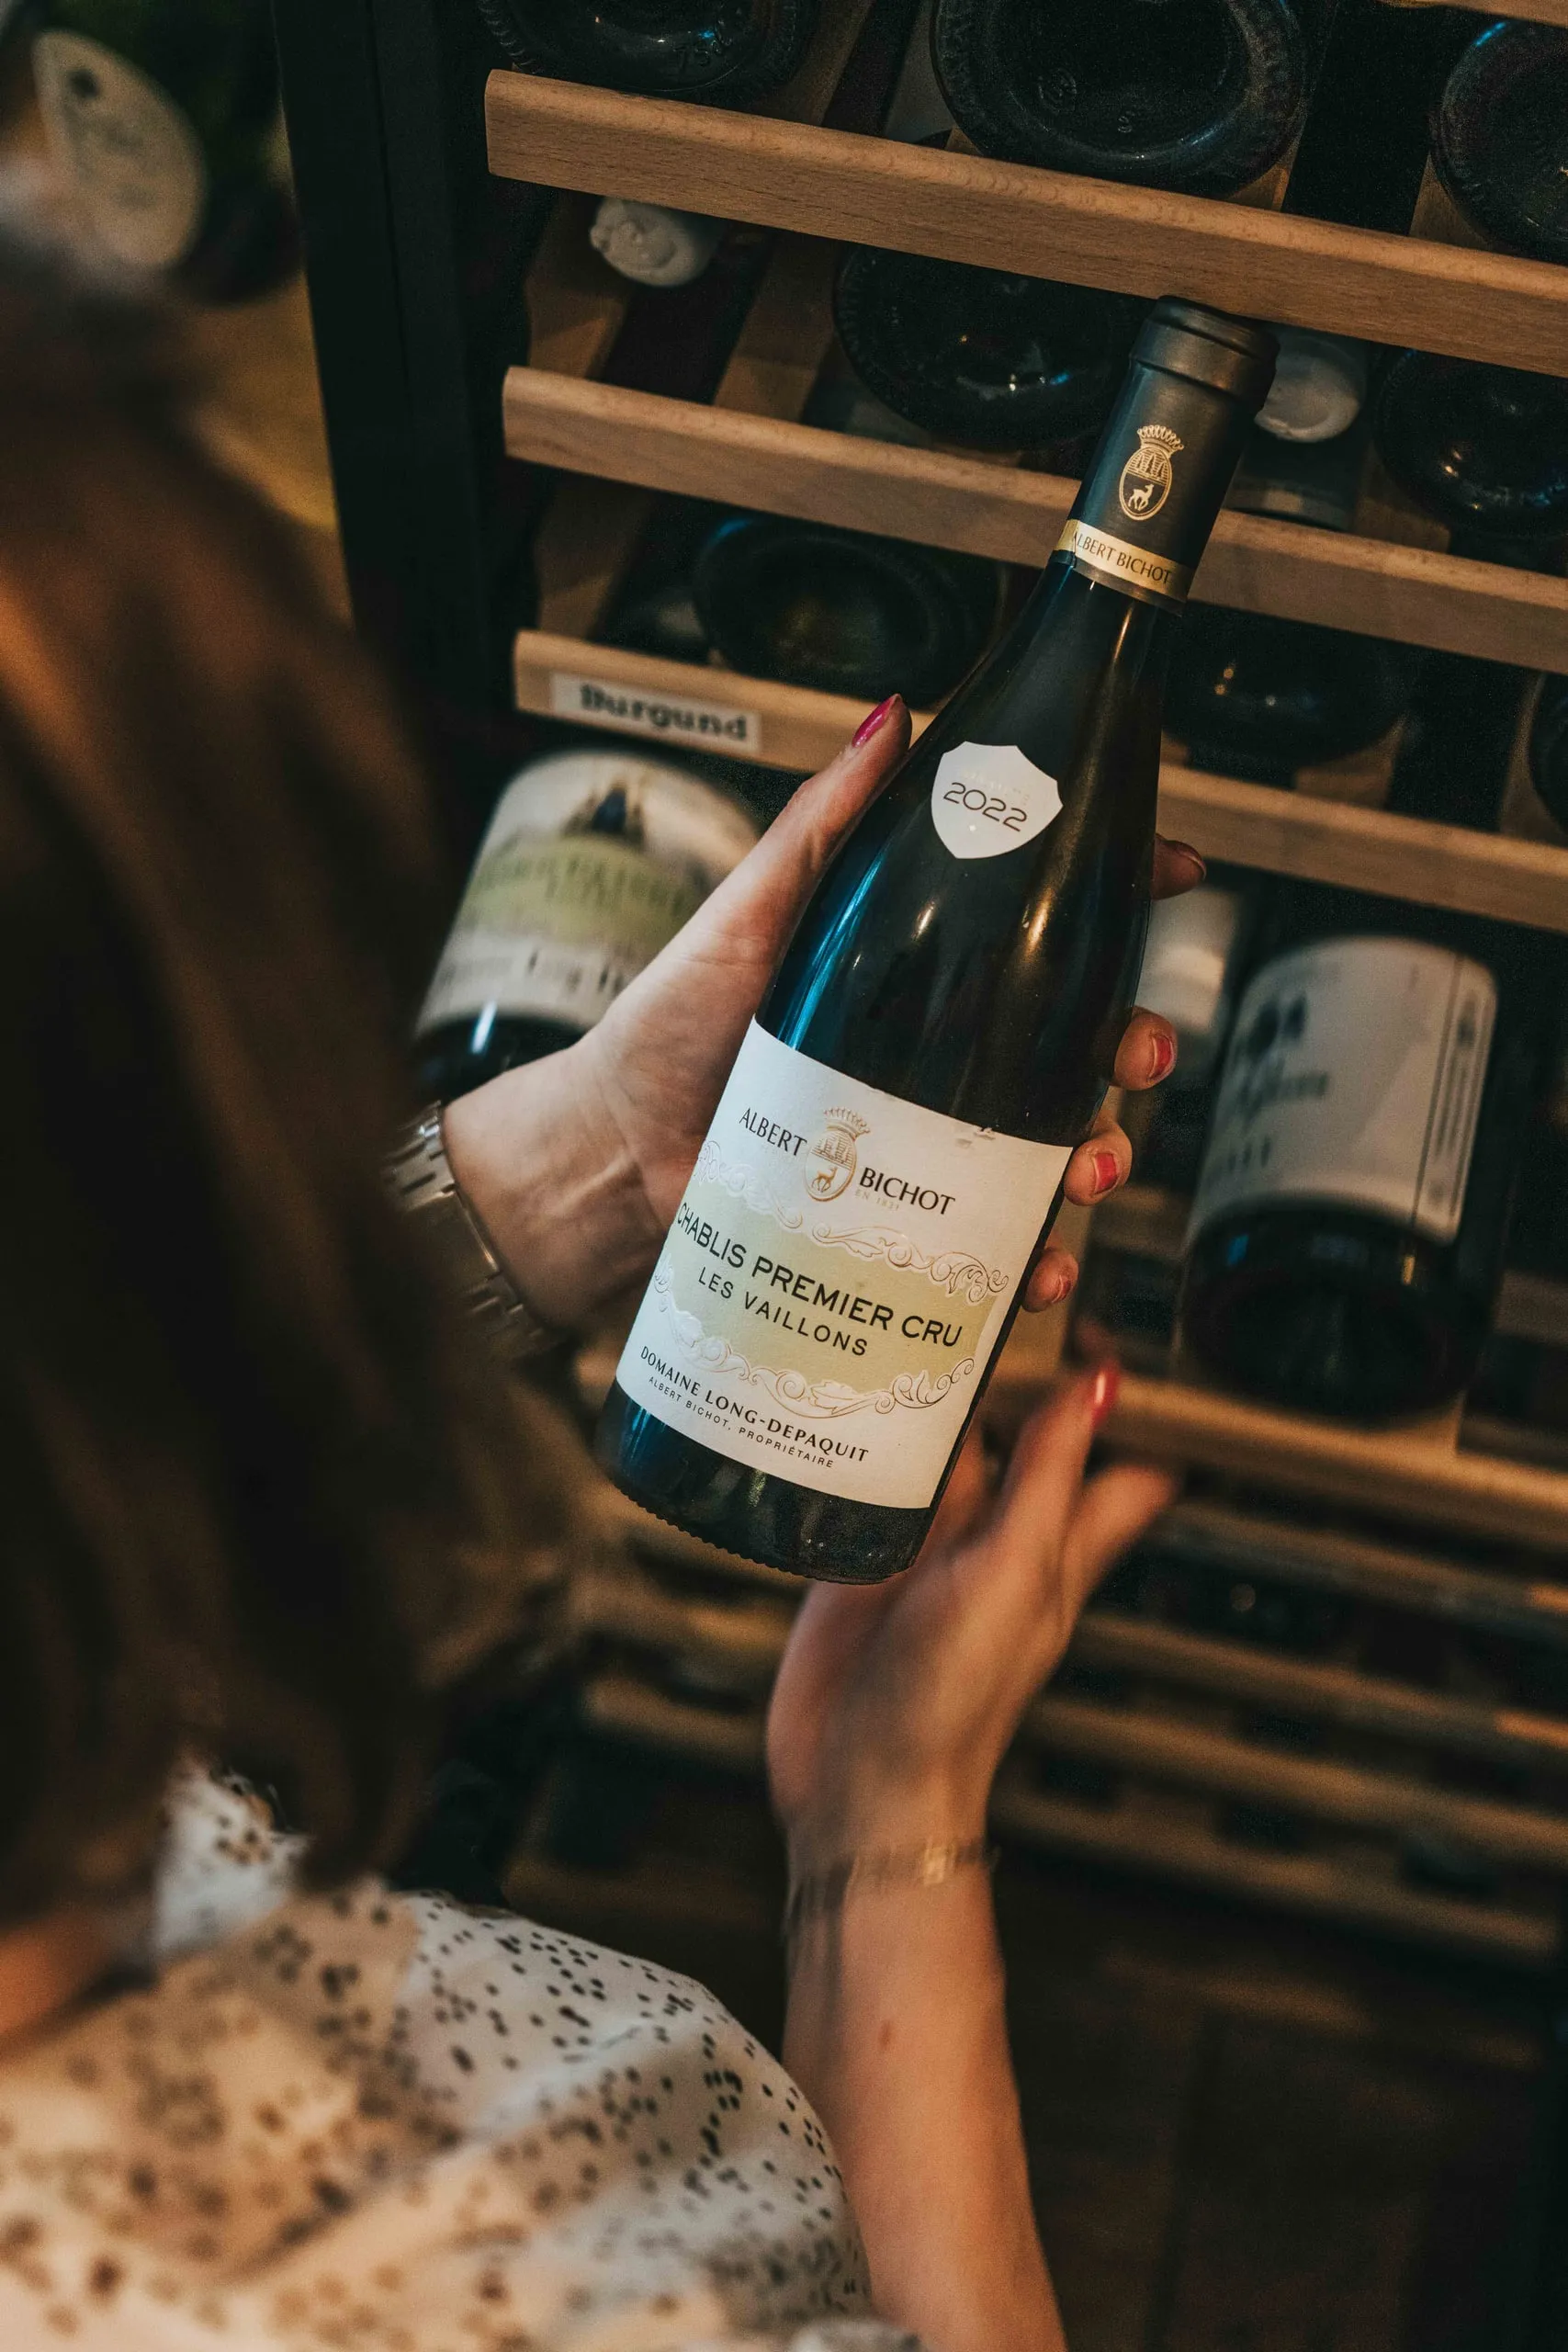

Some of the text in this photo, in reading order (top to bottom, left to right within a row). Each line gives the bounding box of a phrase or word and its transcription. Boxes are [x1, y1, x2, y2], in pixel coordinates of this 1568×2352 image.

[1117, 552, 1172, 584] BICHOT
[580, 684, 748, 741] Burgund
[943, 782, 1028, 832] 2022
[739, 1108, 956, 1215] ALBERT BICHOT
[677, 1202, 964, 1348] CHABLIS PREMIER CRU
[697, 1267, 869, 1357] LES VAILLONS
[640, 1346, 870, 1463] DOMAINE LONG-DEPAQUIT
[649, 1376, 835, 1469] ALBERT BICHOT, PROPRIÉTAIRE
